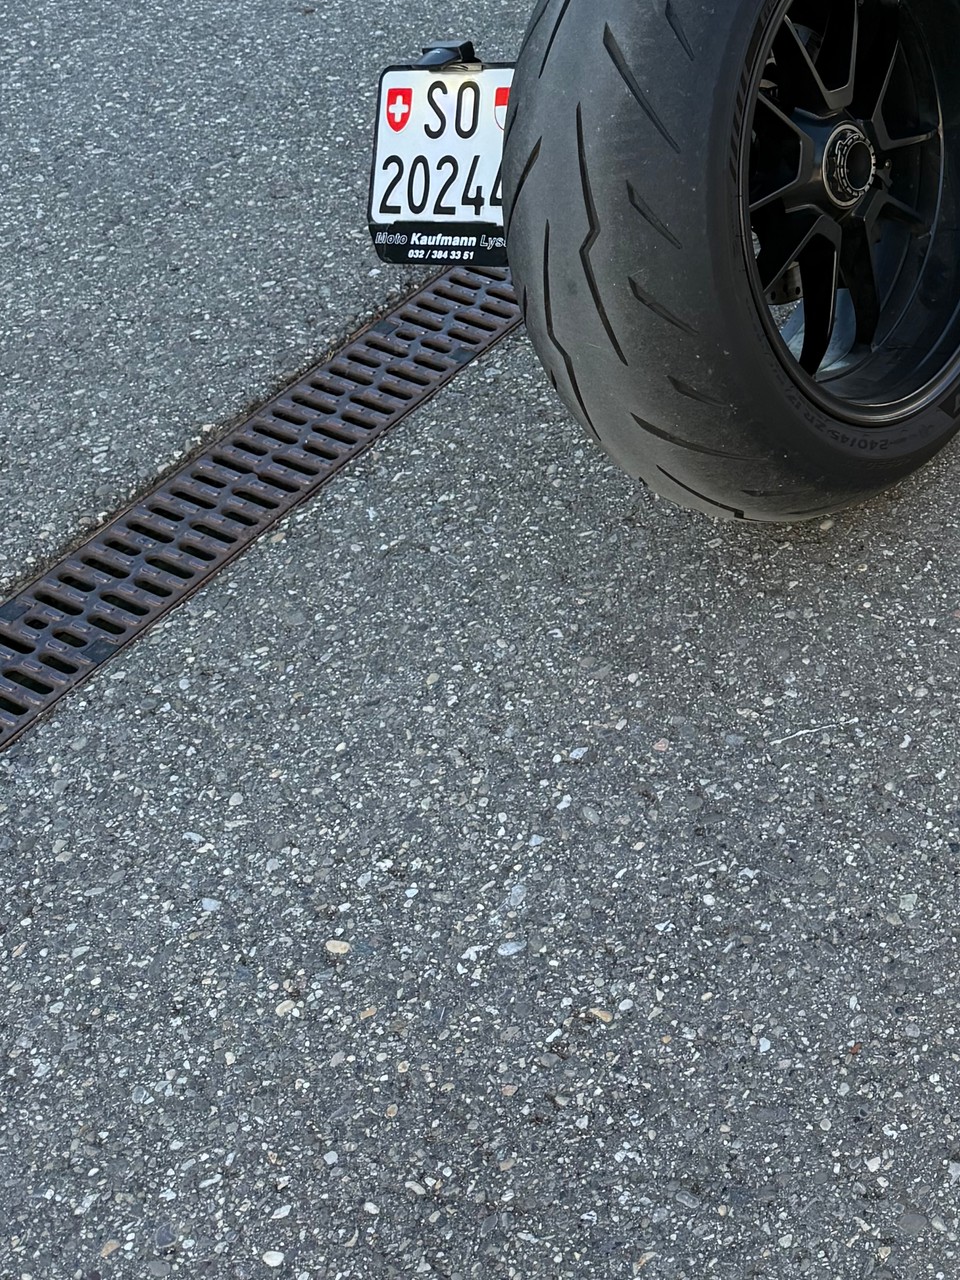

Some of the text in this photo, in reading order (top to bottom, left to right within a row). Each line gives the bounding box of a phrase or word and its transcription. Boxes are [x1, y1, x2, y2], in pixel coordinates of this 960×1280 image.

[423, 80, 481, 140] SO
[410, 233, 477, 247] Kaufmann
[480, 234, 507, 250] Lys
[407, 249, 425, 259] 032
[431, 250, 448, 260] 384
[449, 250, 462, 260] 33
